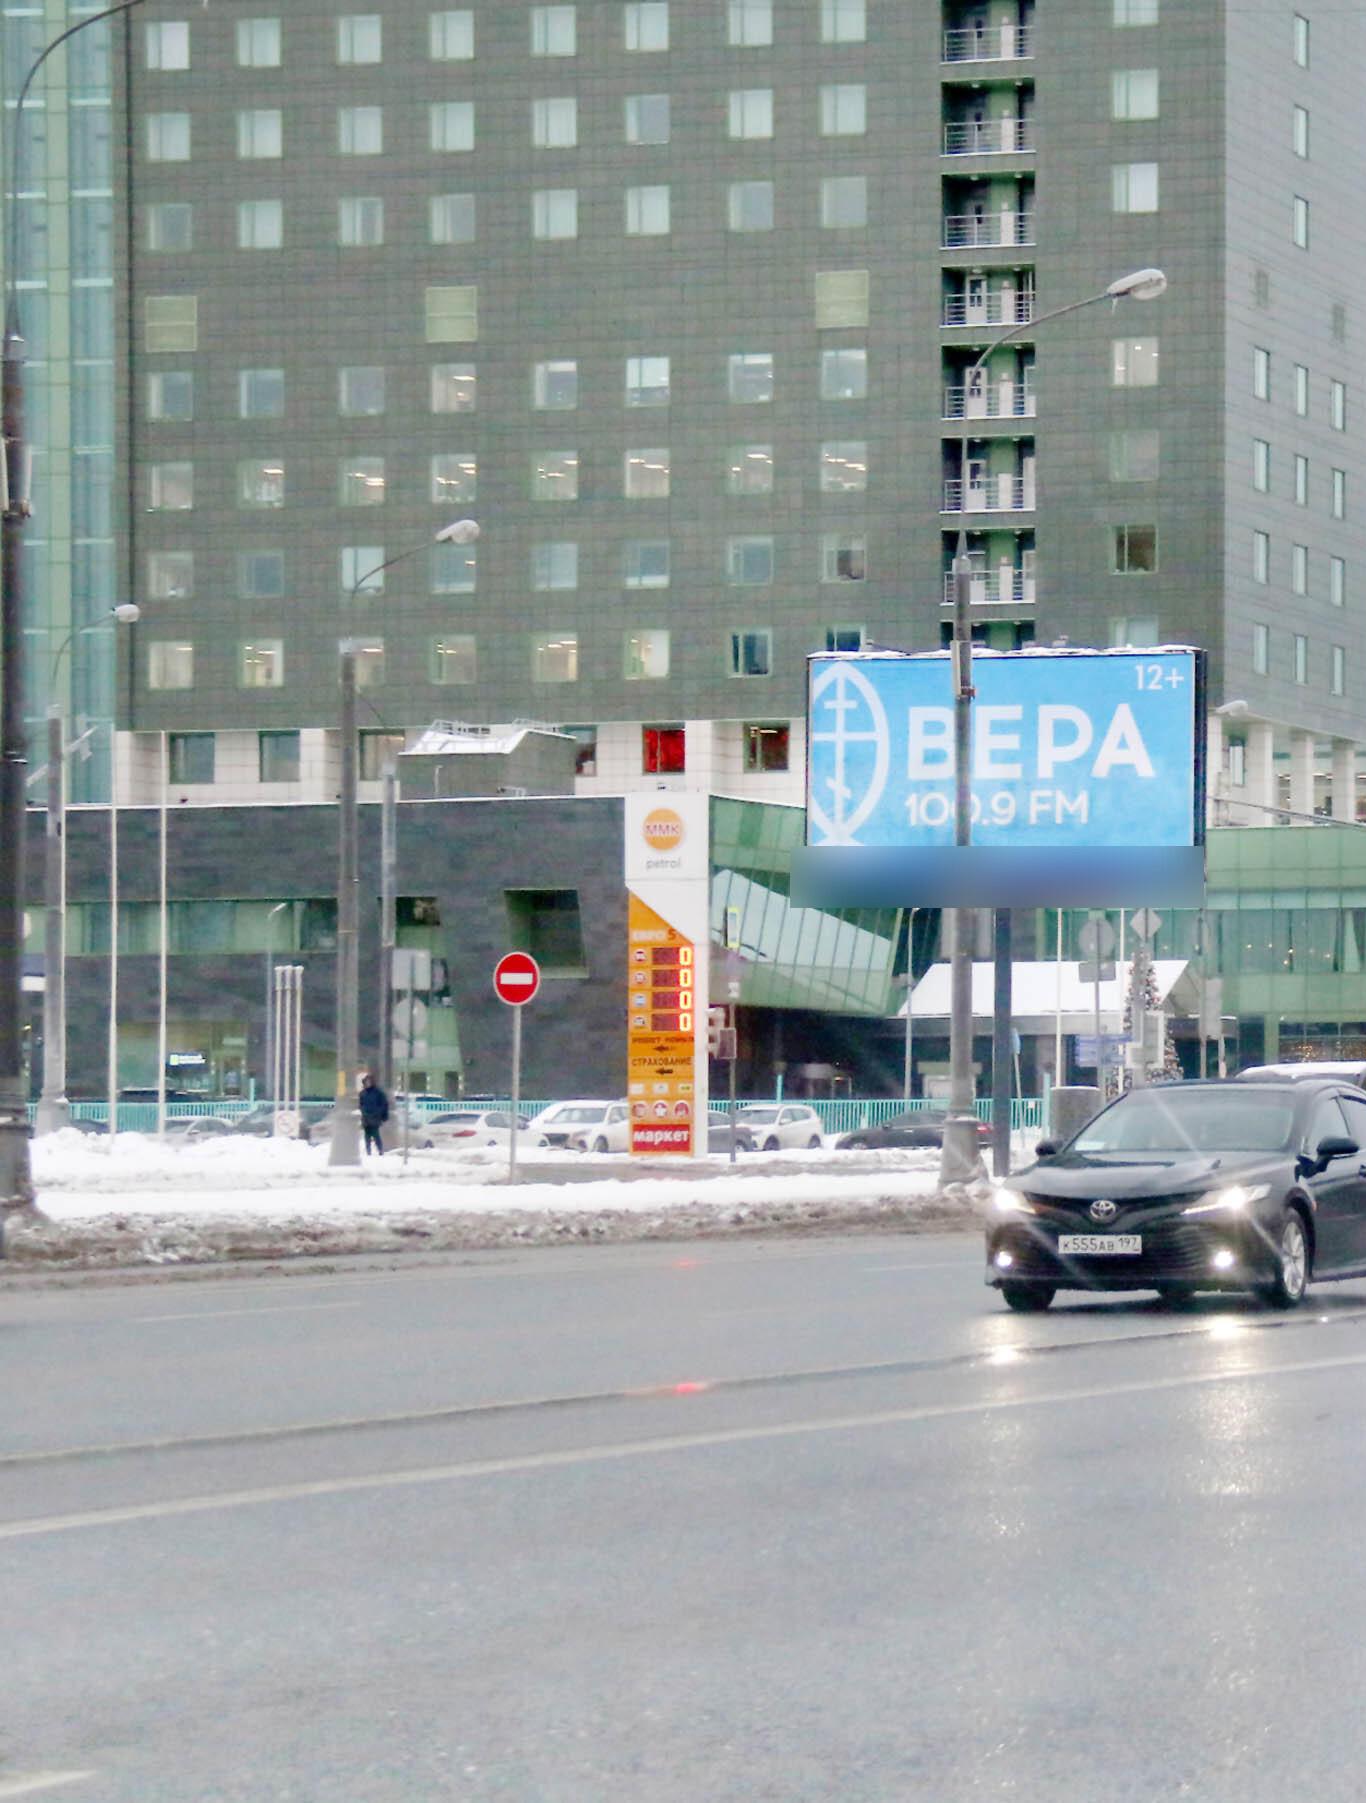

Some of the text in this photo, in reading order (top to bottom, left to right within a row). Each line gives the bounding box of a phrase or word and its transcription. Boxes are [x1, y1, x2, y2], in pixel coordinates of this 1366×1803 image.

[1135, 664, 1184, 690] 12+
[908, 704, 1155, 780] ВЕРА
[1030, 791, 1088, 825] FM
[646, 857, 680, 871] petrol
[634, 1130, 689, 1143] маркет
